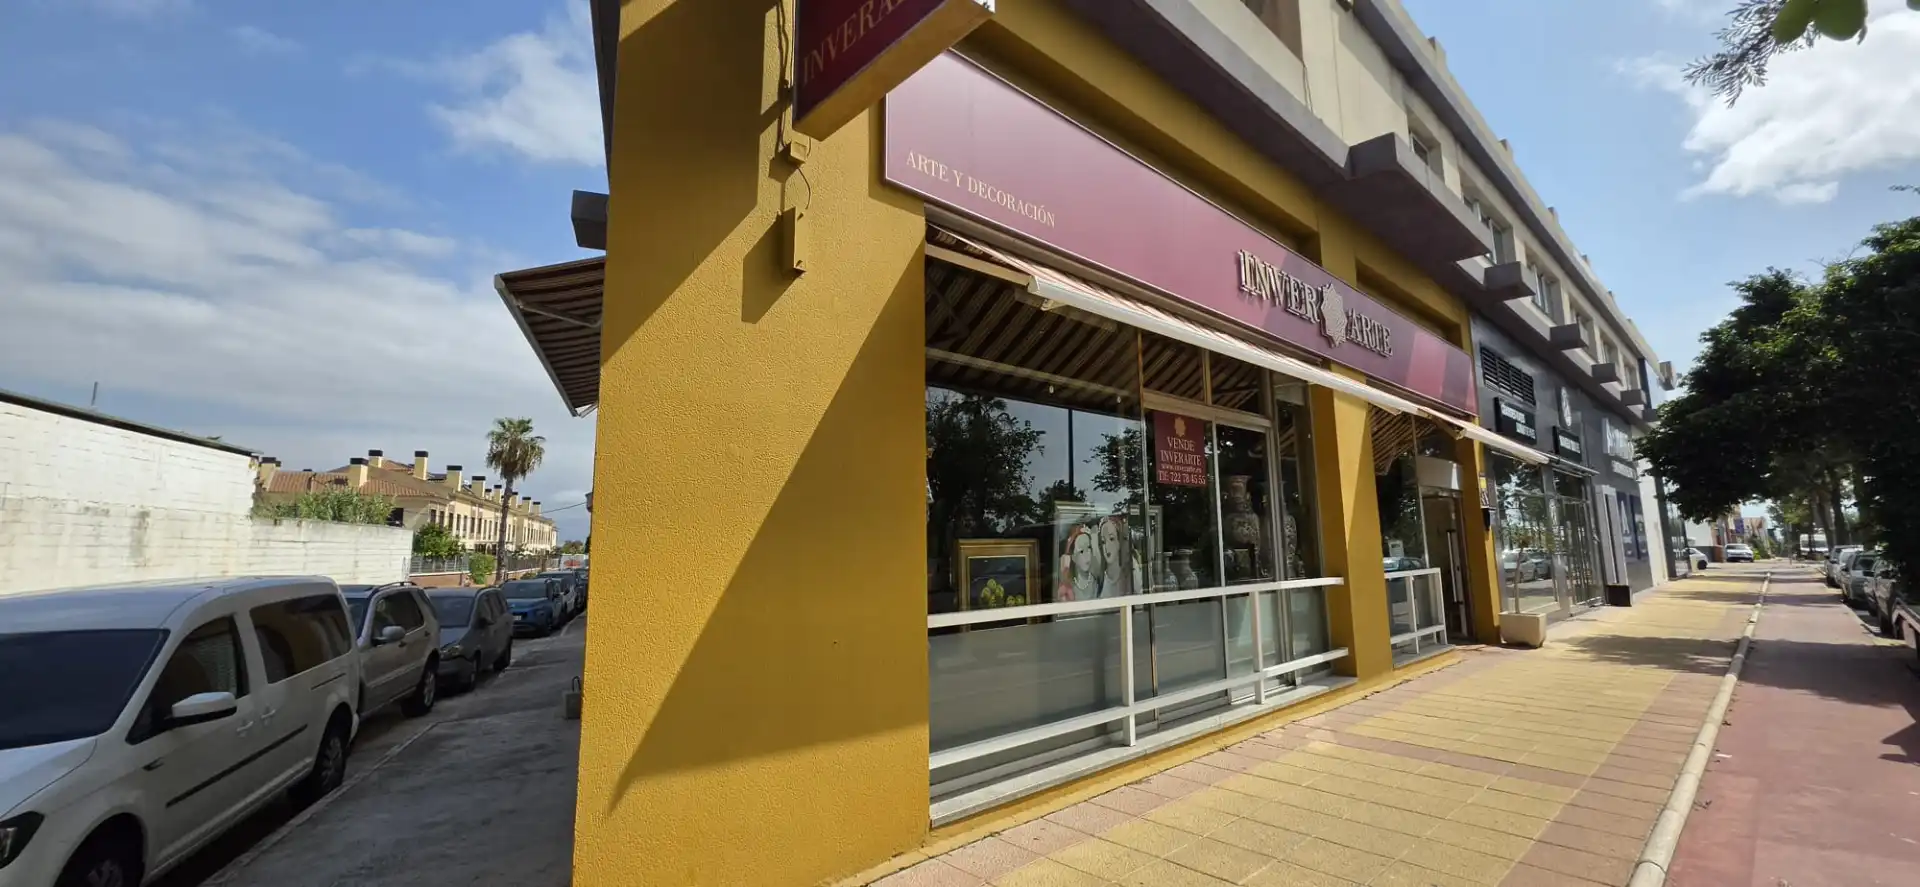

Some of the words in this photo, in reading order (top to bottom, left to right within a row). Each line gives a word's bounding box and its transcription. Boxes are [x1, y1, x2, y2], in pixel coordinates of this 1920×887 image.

[803, 0, 907, 87] INVERA
[906, 149, 949, 182] ARTE
[953, 169, 965, 187] Y
[968, 176, 1055, 229] DECORACIÓN
[1237, 249, 1321, 325] INVER
[1345, 307, 1394, 358] ARTE
[1160, 449, 1202, 466] INVERARTE
[1167, 436, 1195, 452] VENDE
